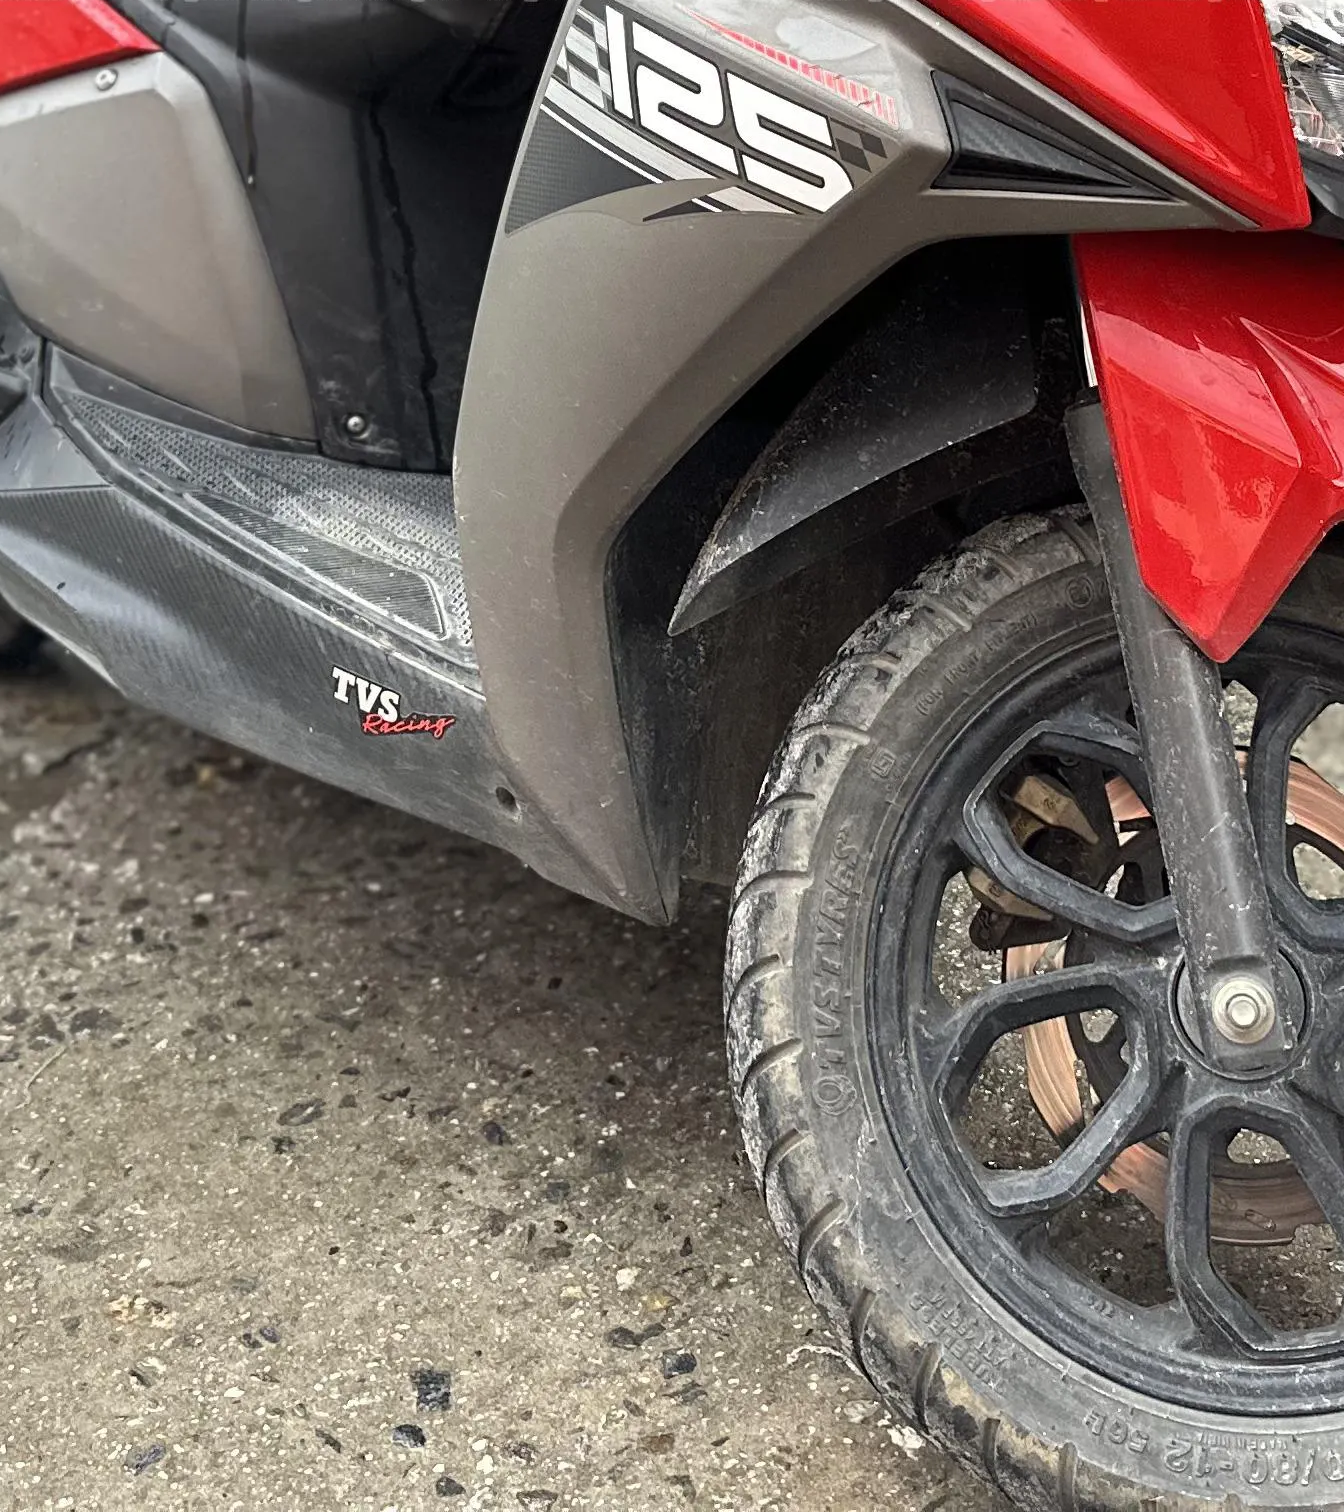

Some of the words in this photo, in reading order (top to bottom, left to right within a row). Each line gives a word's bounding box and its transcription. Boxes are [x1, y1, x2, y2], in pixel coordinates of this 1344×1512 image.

[604, 3, 855, 215] 125
[331, 665, 402, 724] TVS
[362, 712, 455, 738] Racing
